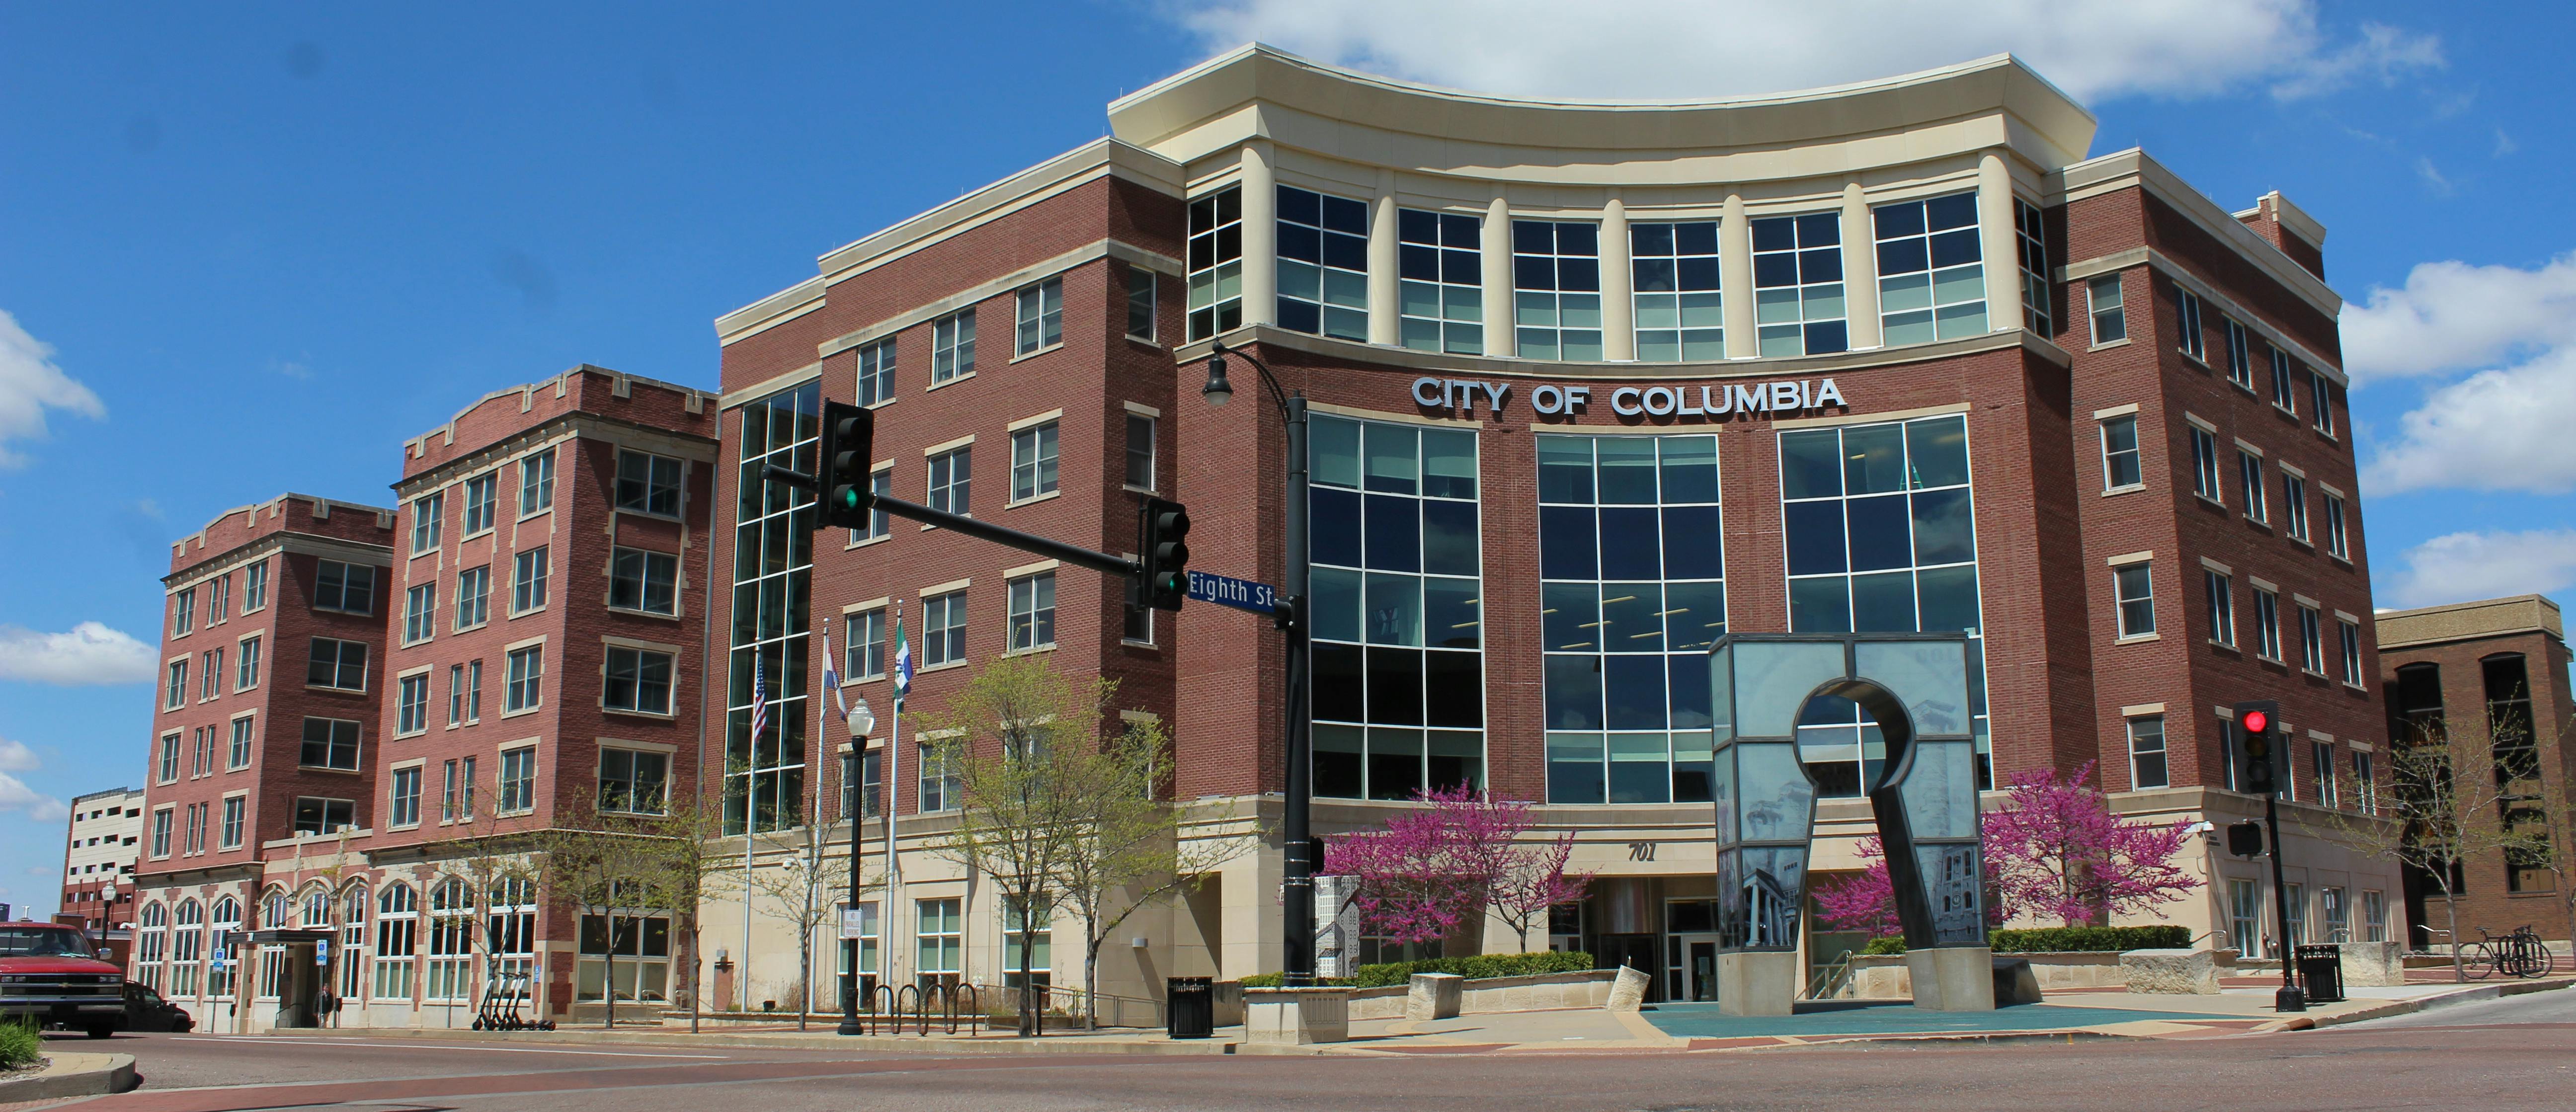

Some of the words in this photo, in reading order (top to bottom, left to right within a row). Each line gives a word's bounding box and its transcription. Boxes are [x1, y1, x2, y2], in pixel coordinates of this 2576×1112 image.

[1412, 377, 1510, 411] CITY
[1531, 385, 1590, 414] OF
[1611, 378, 1848, 415] COLUMBIA
[1190, 573, 1247, 602] Eighth
[1256, 586, 1272, 606] St
[1628, 842, 1656, 862] 701
